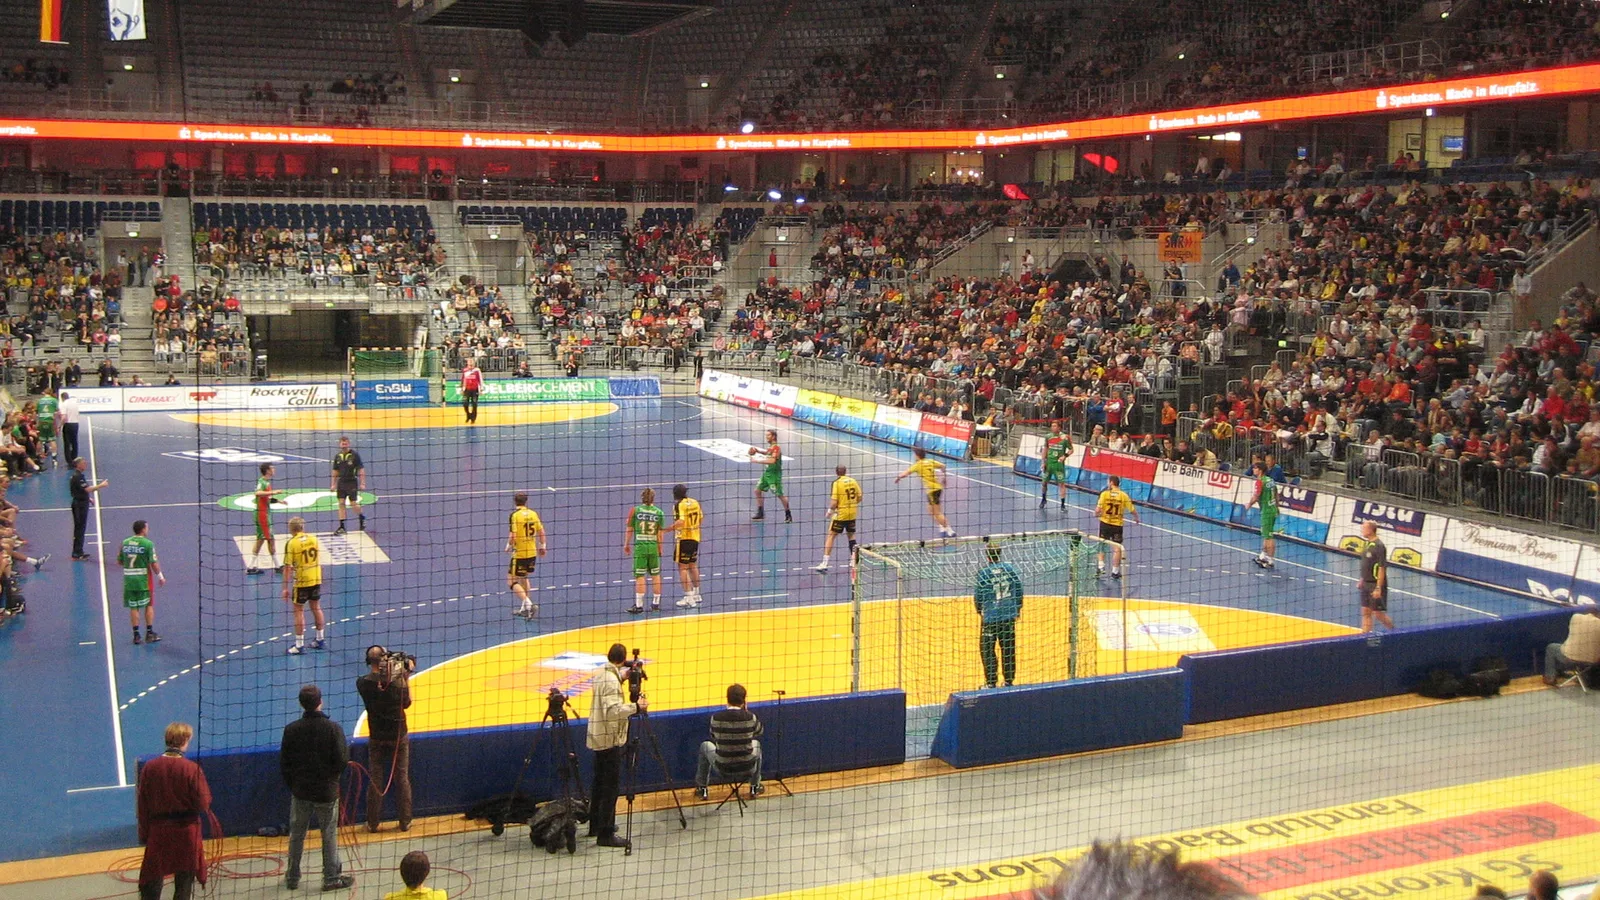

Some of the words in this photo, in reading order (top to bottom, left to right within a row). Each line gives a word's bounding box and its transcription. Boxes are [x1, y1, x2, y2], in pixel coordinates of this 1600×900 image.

[1476, 86, 1486, 97] in
[250, 386, 318, 396] Rockwell
[375, 383, 412, 394] EnBW
[288, 393, 336, 406] Collins
[1162, 461, 1177, 474] Die
[1180, 464, 1204, 479] Bahn
[845, 487, 856, 500] 13
[1105, 502, 1120, 515] 21
[688, 511, 699, 525] 17
[523, 522, 536, 537] 15
[639, 521, 656, 535] 13
[1460, 525, 1517, 553] Premium
[1517, 536, 1558, 561] Biere
[127, 554, 138, 568] 7
[301, 547, 318, 564] 19
[1246, 799, 1426, 839] Fanclub
[927, 855, 1068, 889] Lions
[1480, 852, 1563, 879] SG
